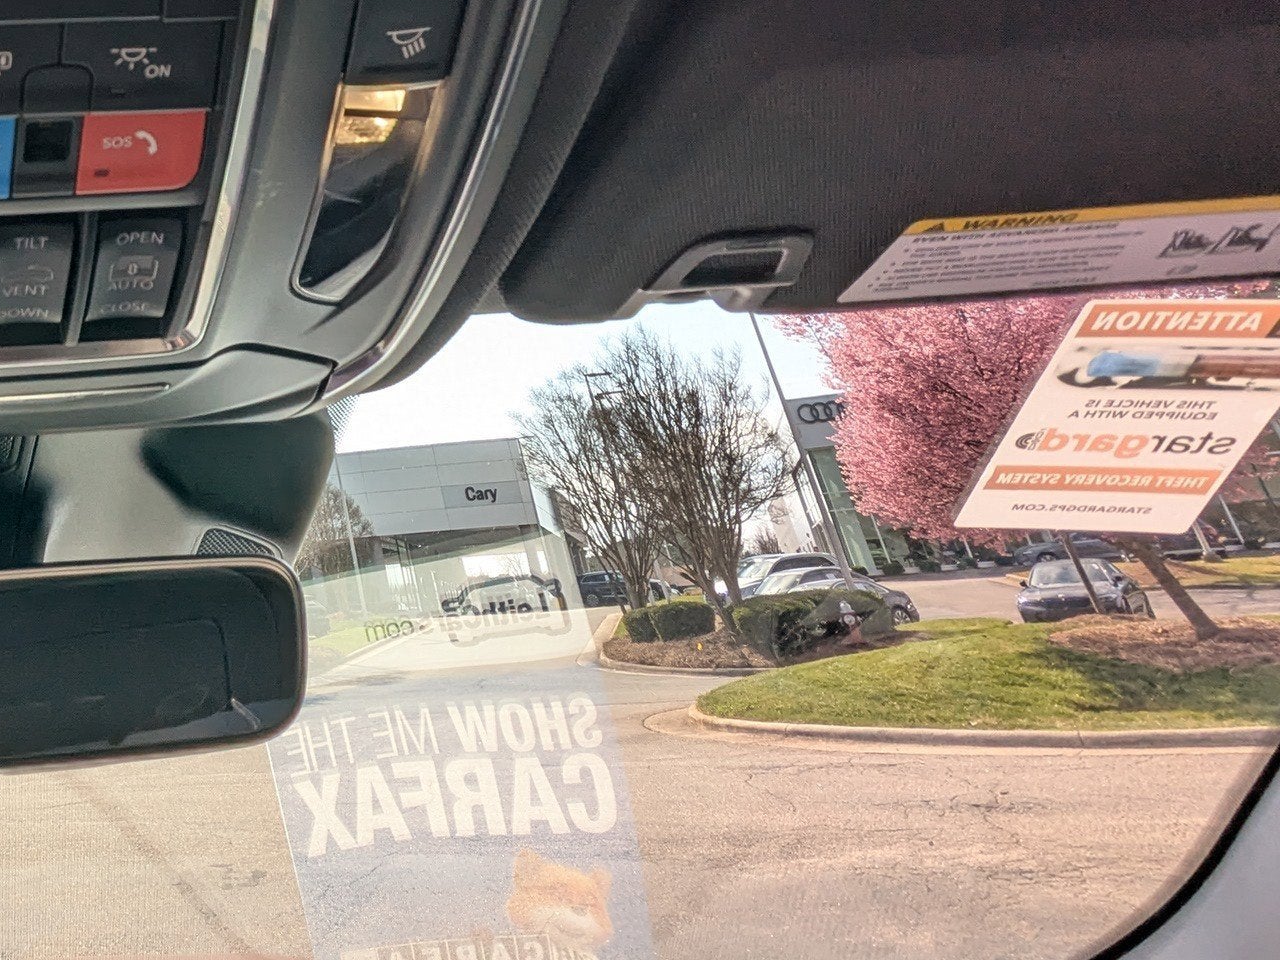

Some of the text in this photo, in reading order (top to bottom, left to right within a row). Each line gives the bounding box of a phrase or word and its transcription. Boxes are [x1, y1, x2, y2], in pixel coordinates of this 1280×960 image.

[144, 63, 173, 79] ON
[102, 136, 133, 150] SOS
[963, 213, 1080, 230] WARNING
[14, 235, 49, 250] TILT
[116, 231, 165, 246] OPEN
[1, 284, 48, 299] VENT
[108, 278, 155, 292] AUTO
[100, 301, 151, 316] CLOSE
[464, 486, 498, 503] Cary
